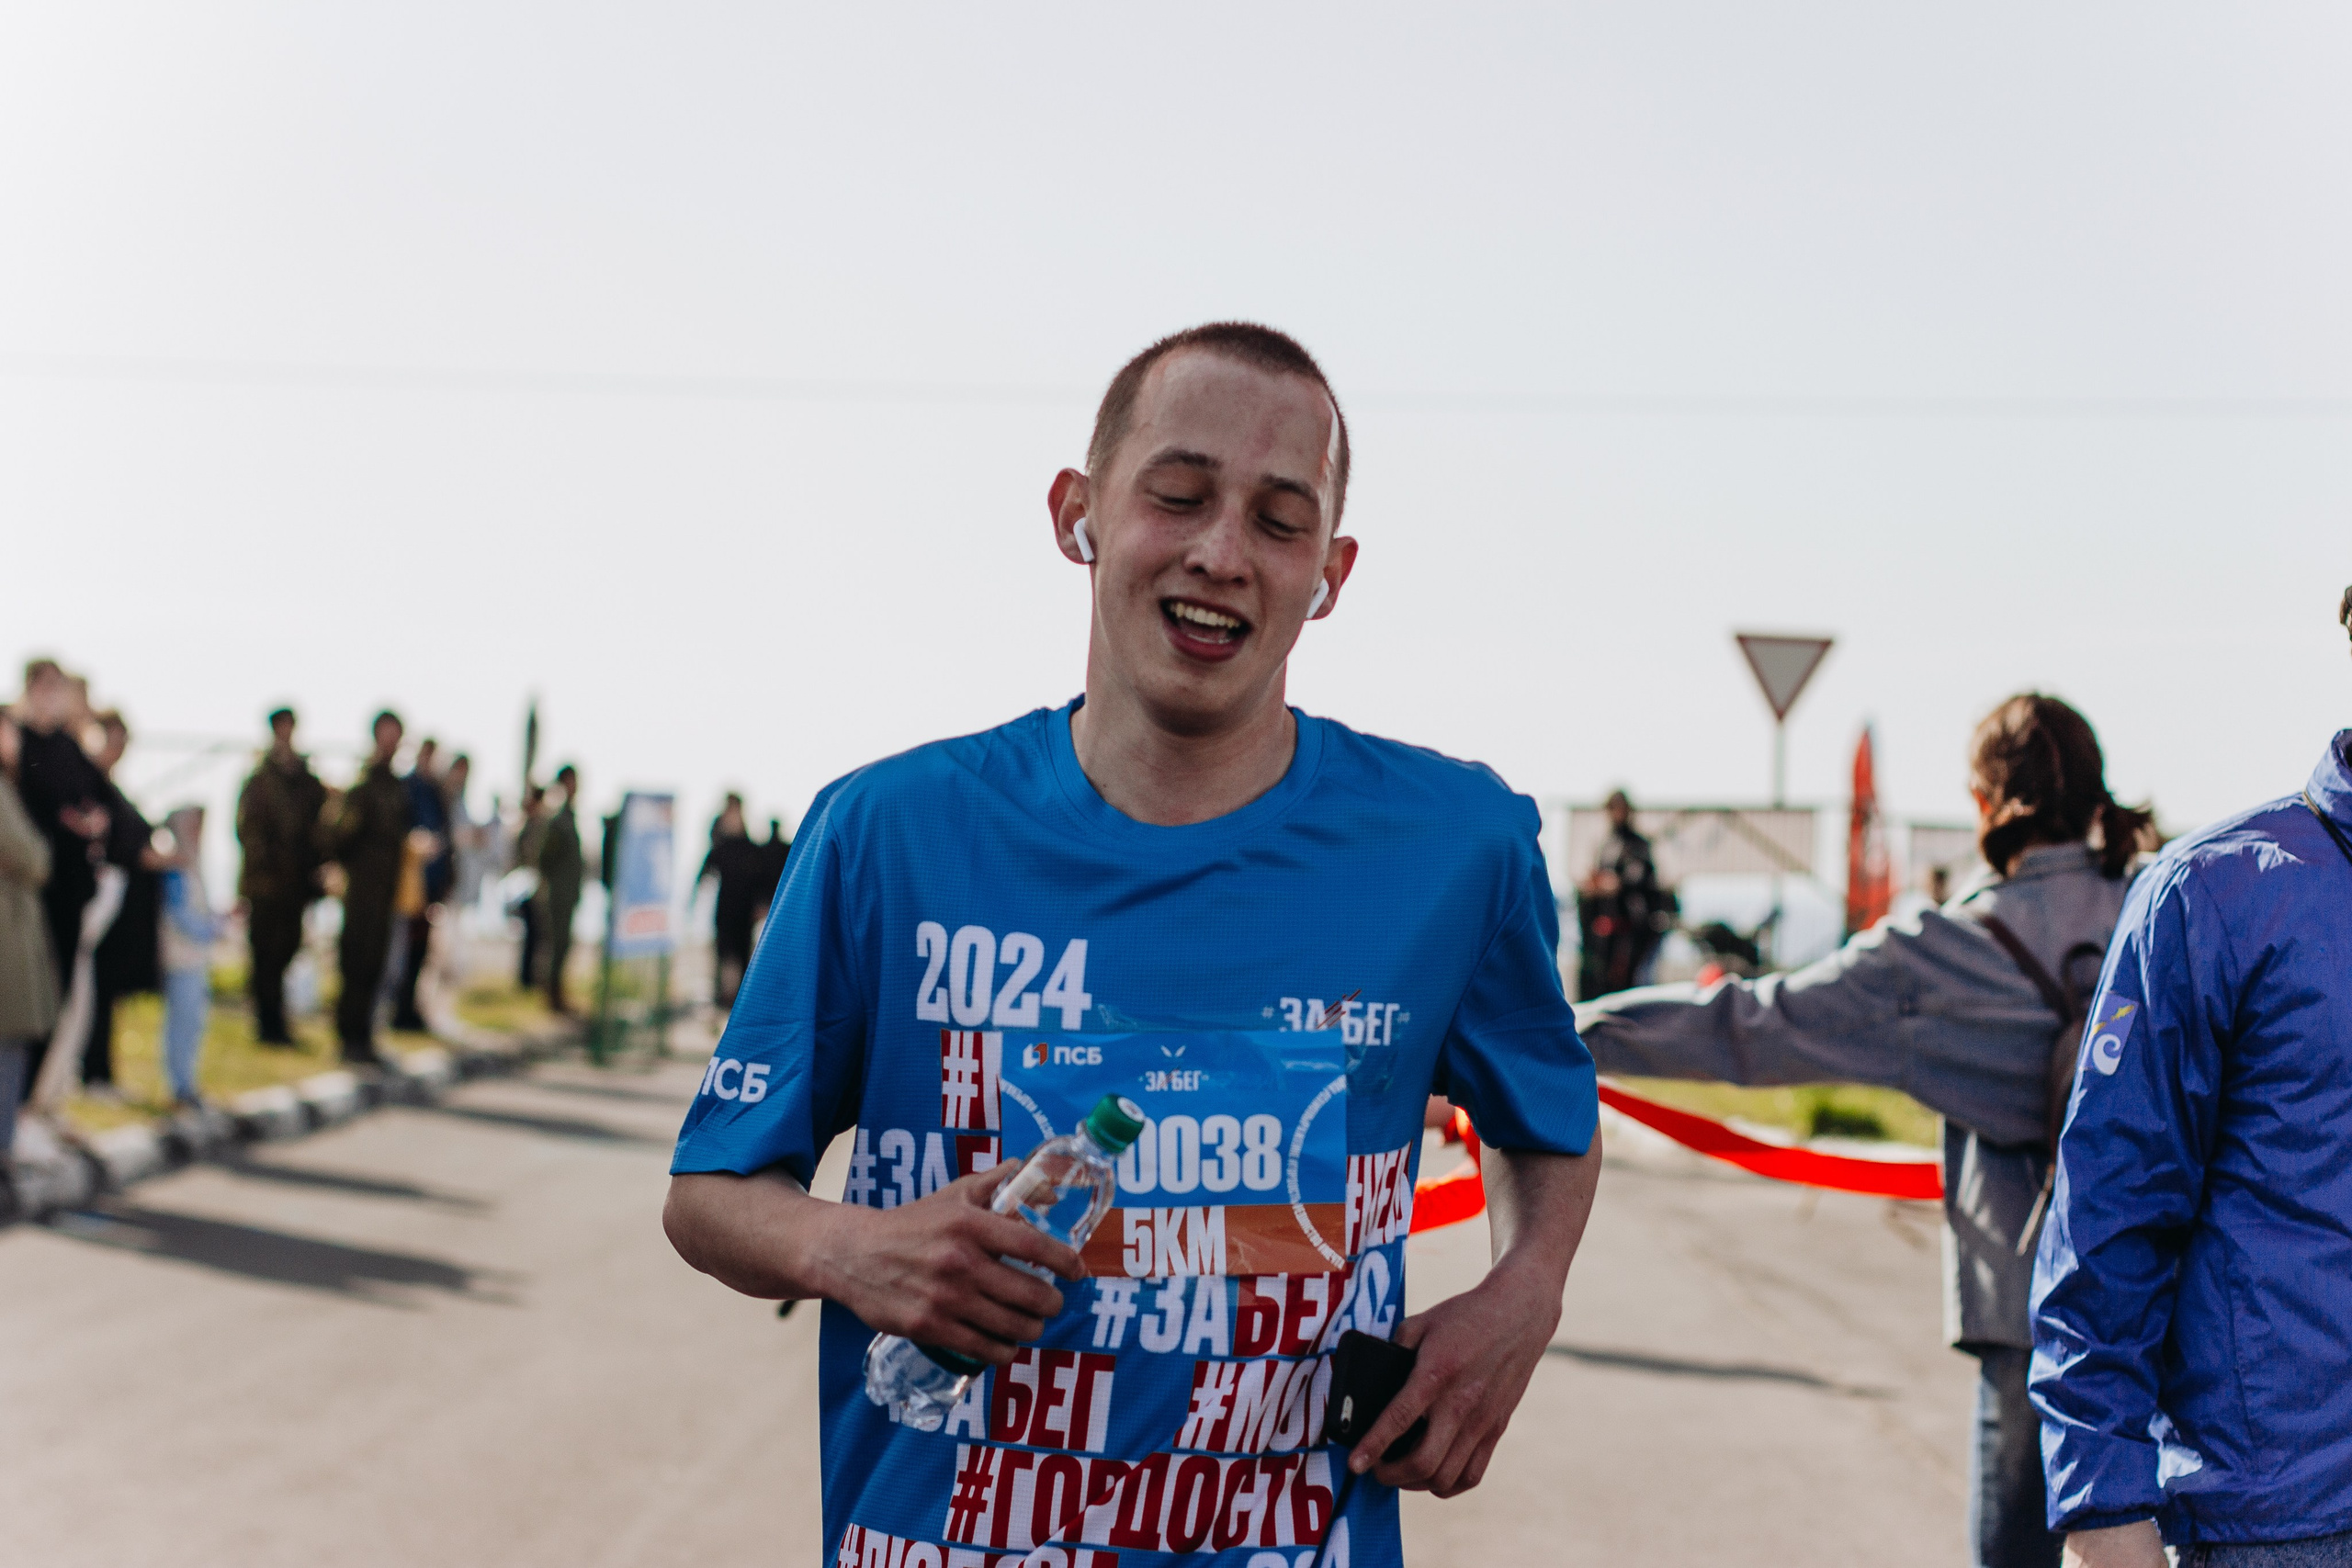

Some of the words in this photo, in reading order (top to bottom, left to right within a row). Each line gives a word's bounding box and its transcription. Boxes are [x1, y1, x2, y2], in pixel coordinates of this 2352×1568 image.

[916, 920, 1092, 1031] 2024
[1054, 1045, 1103, 1066] ПСБ
[948, 1443, 1334, 1554] #ГОРДОСТЬ
